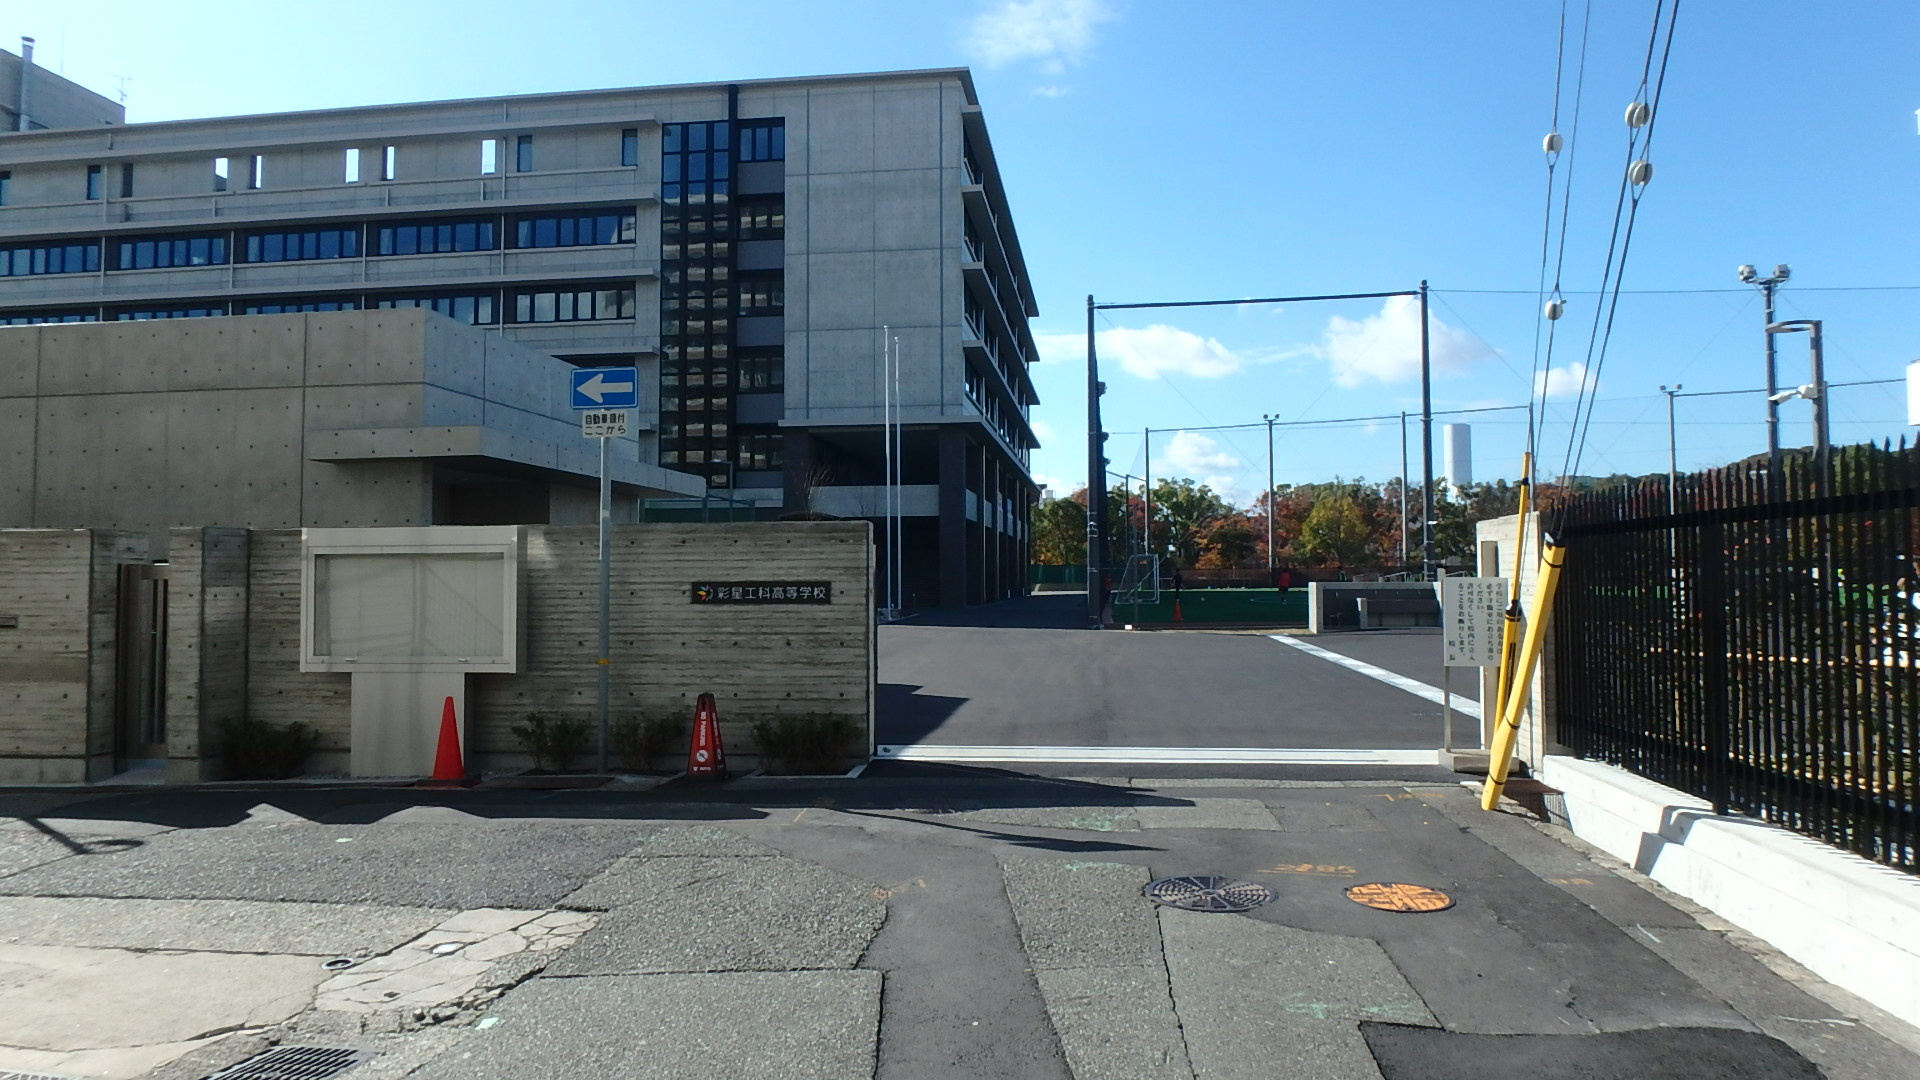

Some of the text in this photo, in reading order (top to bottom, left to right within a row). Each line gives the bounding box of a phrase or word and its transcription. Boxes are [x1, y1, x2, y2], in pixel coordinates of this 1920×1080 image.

[584, 425, 626, 436] ここから
[717, 586, 826, 600] 彩星工科高等学校
